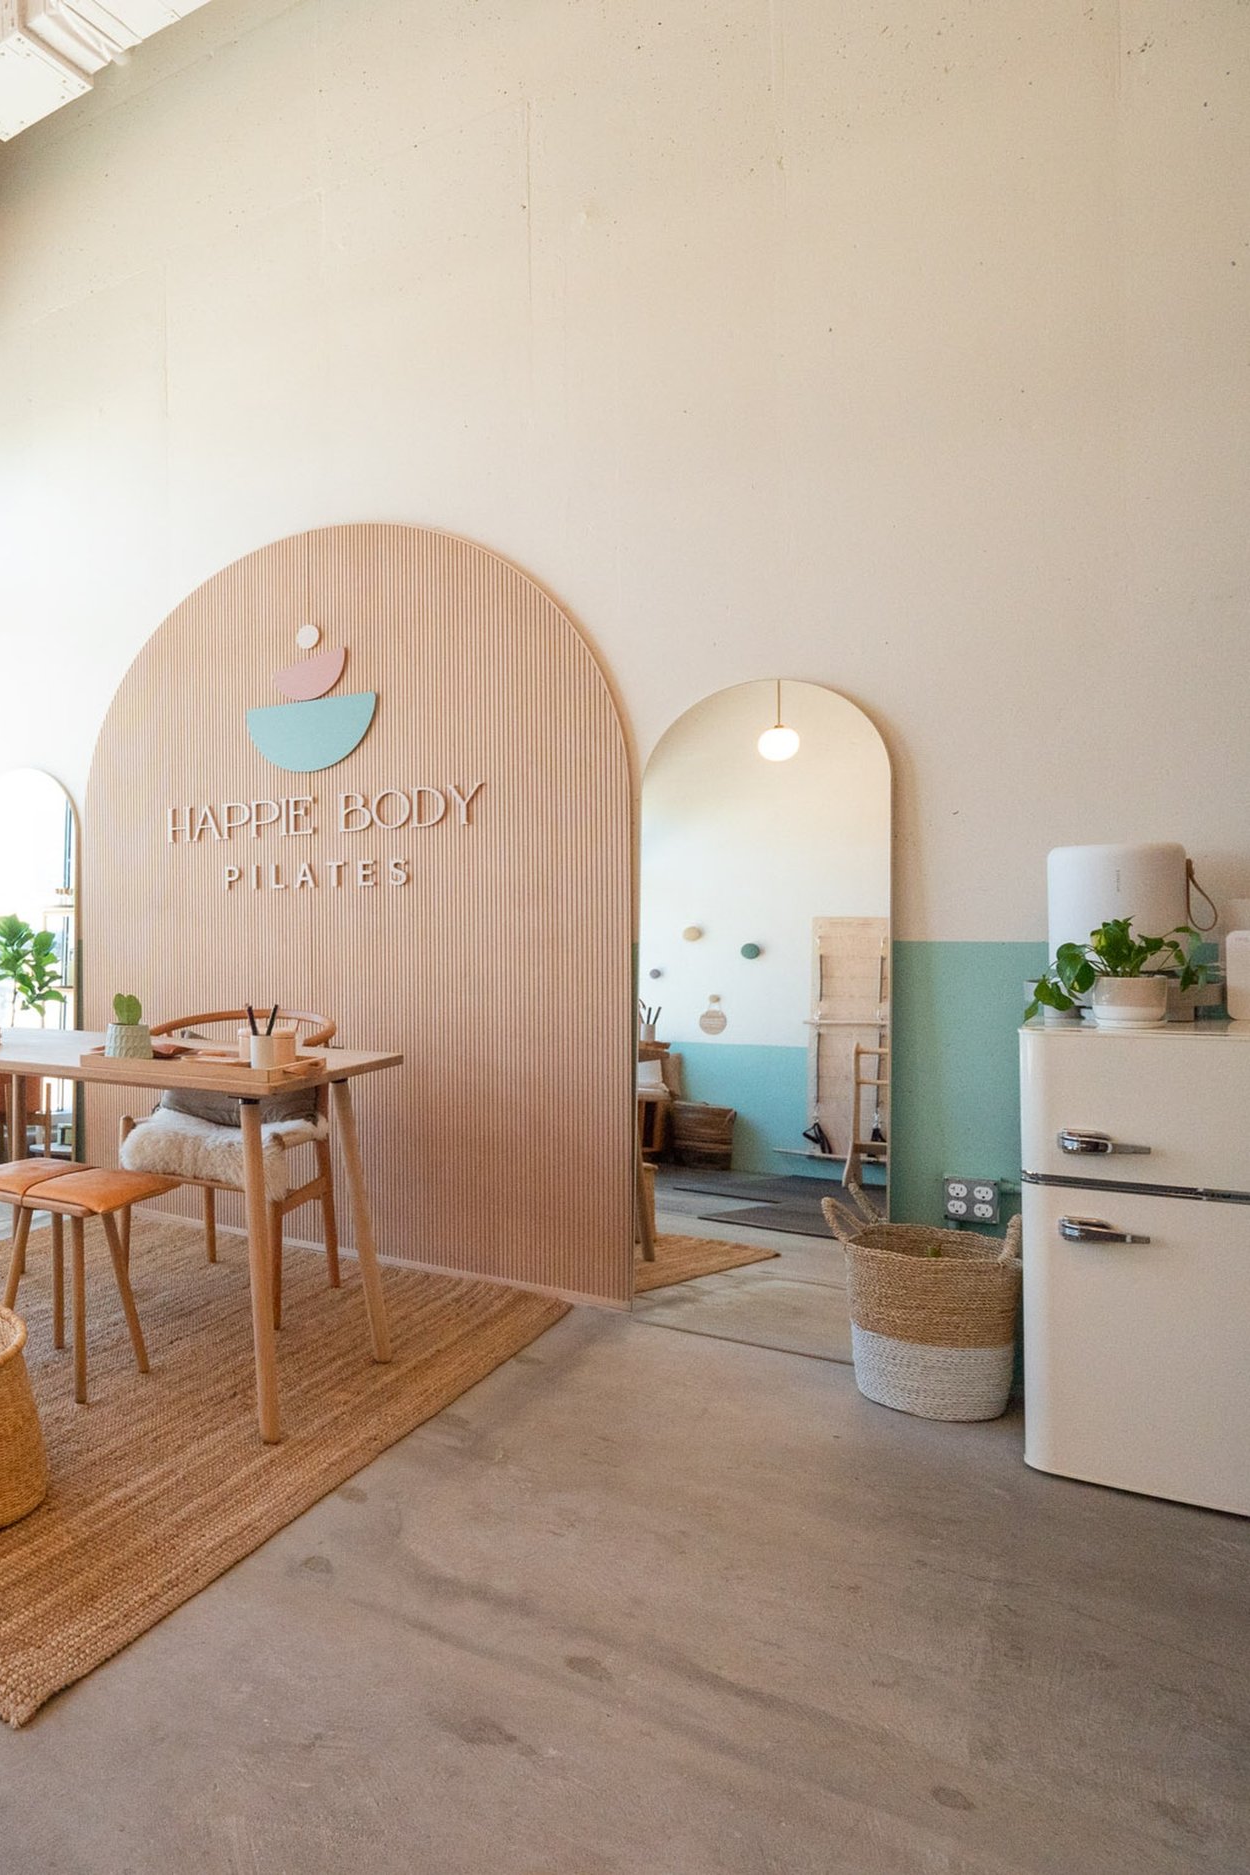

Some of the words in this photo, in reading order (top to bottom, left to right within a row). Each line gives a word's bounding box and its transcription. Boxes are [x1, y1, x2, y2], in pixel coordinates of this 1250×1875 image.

[166, 795, 318, 844] HAPPIE
[338, 781, 486, 834] BODY
[223, 857, 411, 892] PILATES
